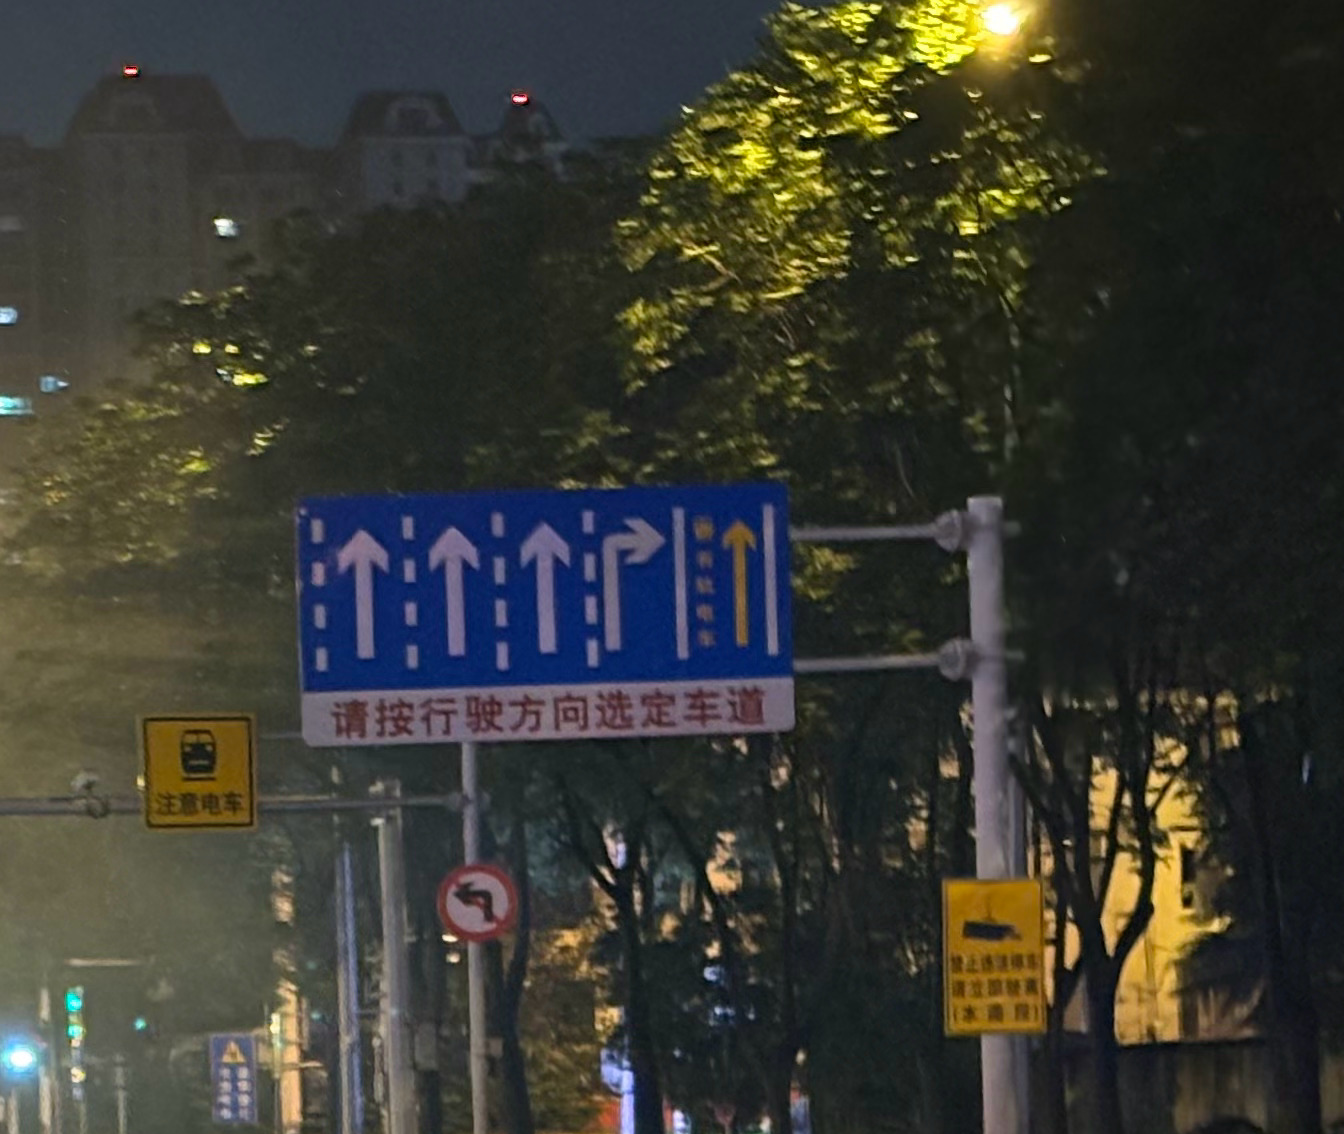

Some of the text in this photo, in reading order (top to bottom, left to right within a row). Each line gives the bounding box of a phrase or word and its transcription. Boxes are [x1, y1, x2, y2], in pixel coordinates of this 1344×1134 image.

[331, 688, 766, 740] 请按行驶方向选定车道
[155, 790, 244, 816] 注意电车
